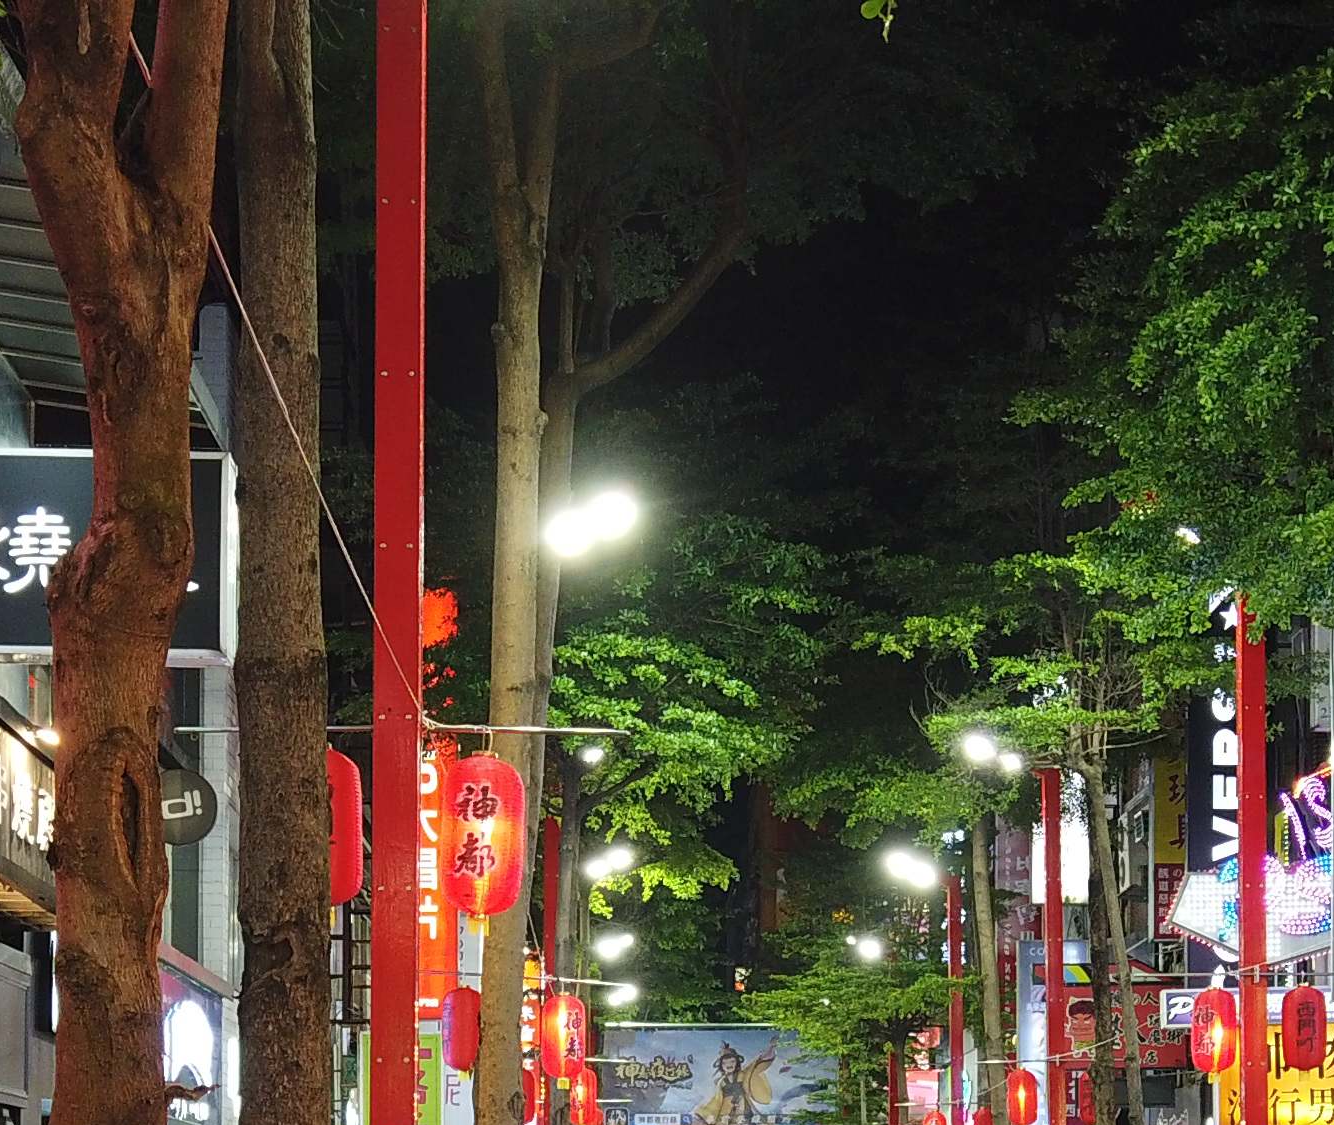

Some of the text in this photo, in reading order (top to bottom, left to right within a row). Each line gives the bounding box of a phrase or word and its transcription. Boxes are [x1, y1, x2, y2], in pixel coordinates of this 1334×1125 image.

[454, 785, 500, 877] 神都
[1297, 1002, 1315, 1051] 西門町
